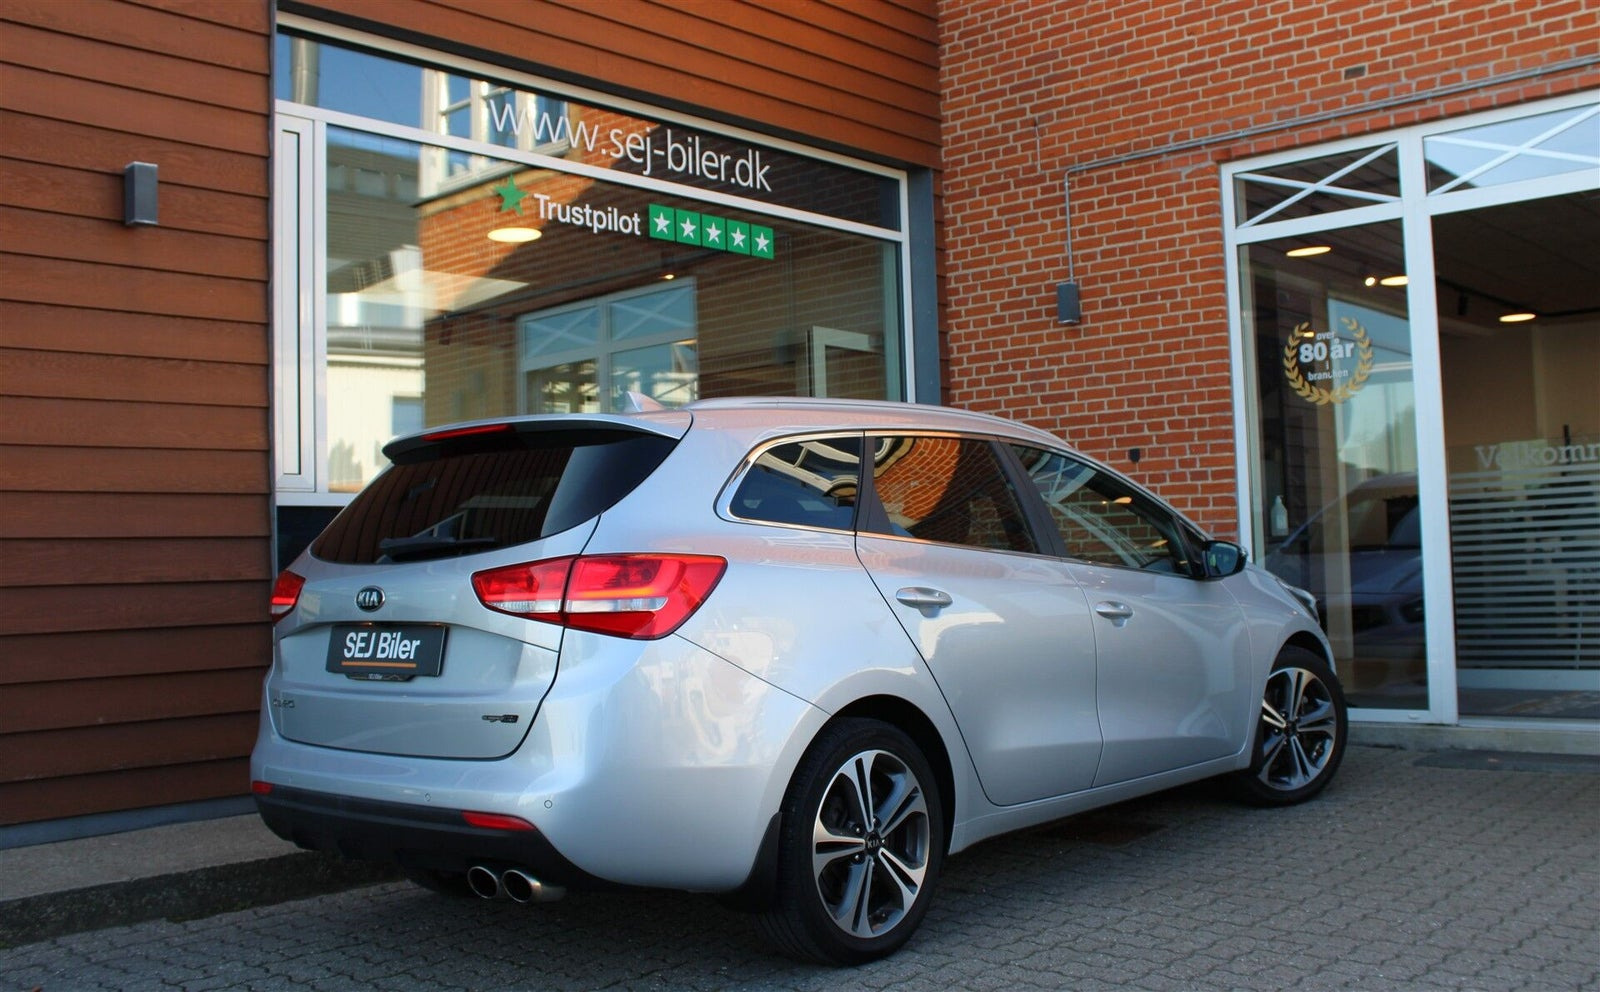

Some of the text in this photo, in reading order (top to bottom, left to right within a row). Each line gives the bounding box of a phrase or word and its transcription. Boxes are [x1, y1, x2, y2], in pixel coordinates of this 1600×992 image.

[489, 98, 772, 192] www.sej-biler.dk
[533, 193, 641, 236] Trustpilot
[1316, 331, 1336, 341] over
[1299, 337, 1355, 363] 80 år
[357, 591, 379, 607] KIA
[343, 631, 421, 660] SEJ Biler
